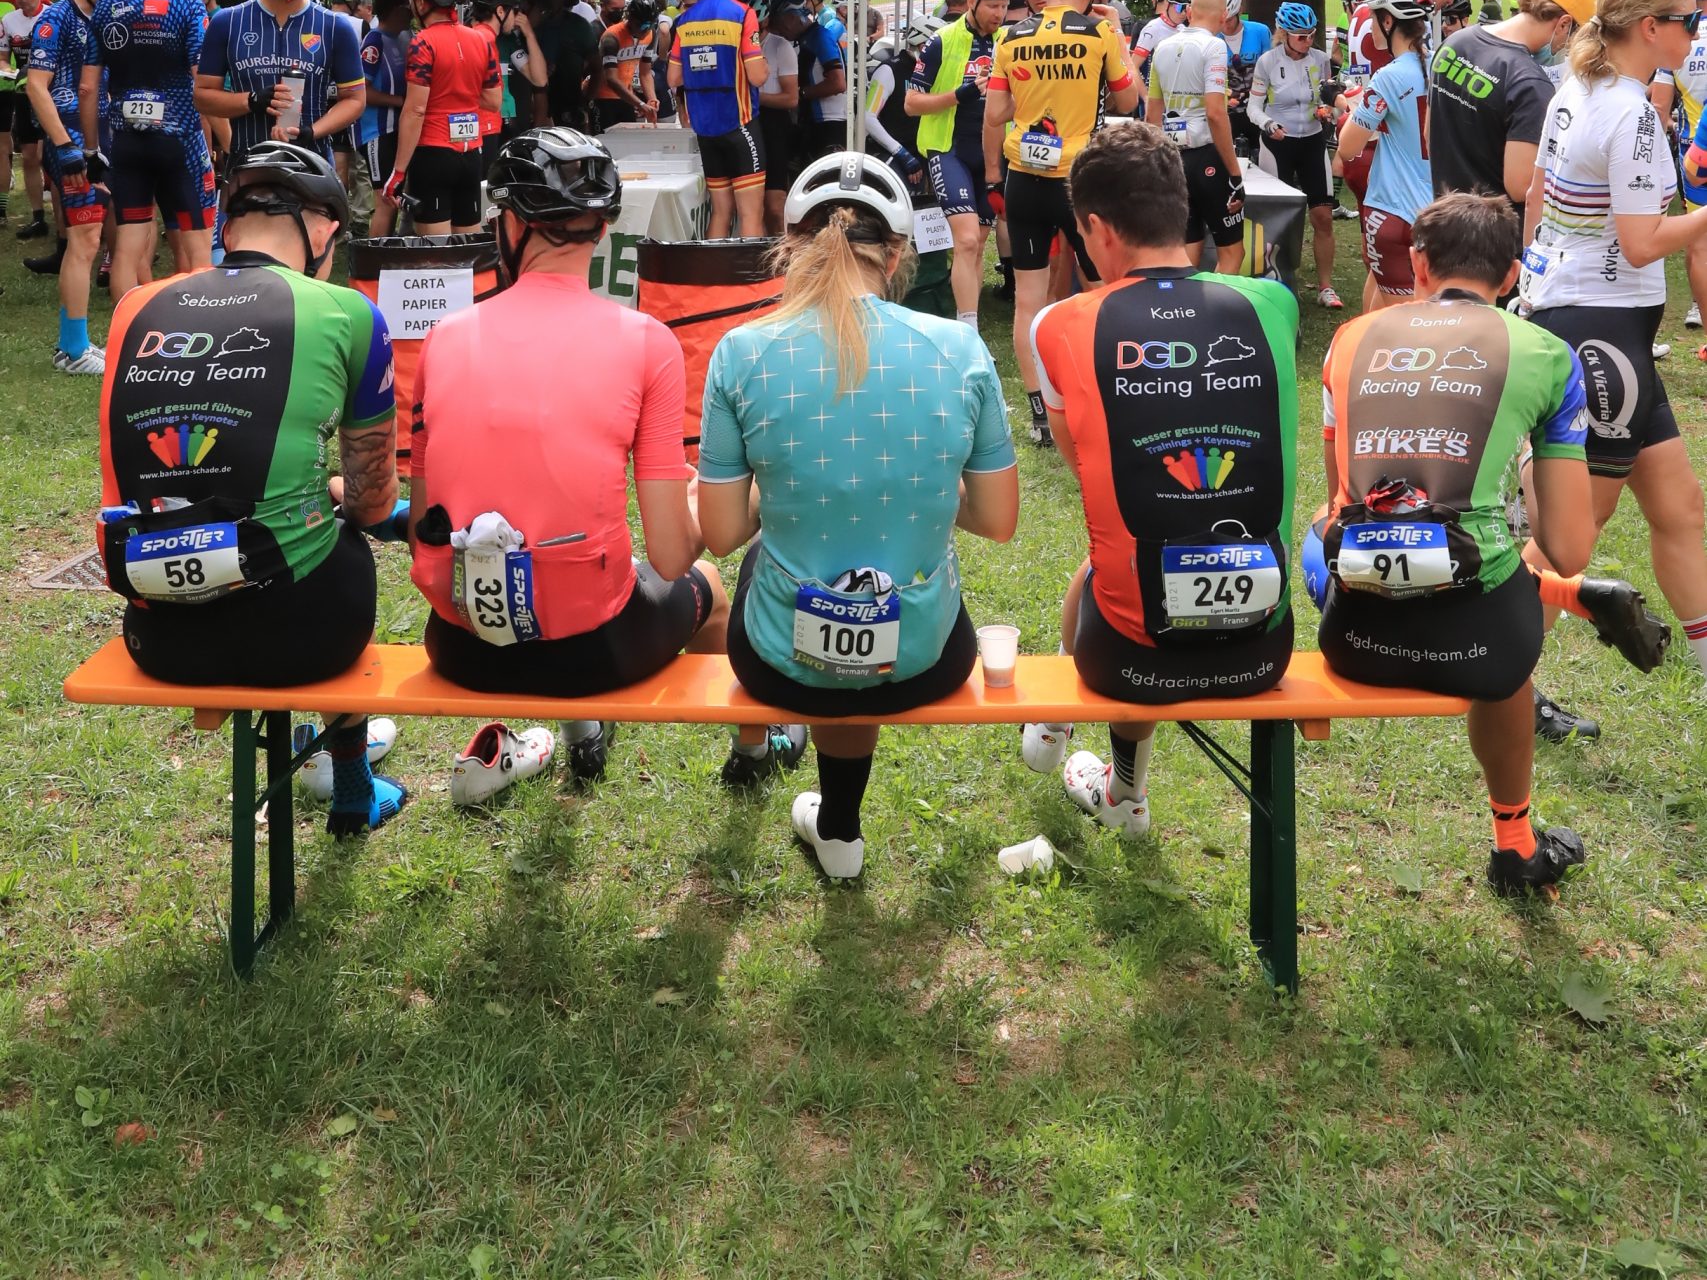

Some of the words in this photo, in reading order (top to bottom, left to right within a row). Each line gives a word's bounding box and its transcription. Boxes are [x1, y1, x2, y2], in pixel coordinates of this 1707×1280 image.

[698, 54, 709, 64] 94
[1012, 43, 1087, 62] JUMBO
[30, 59, 56, 69] URICH
[1035, 63, 1087, 80] VISMA
[1431, 46, 1494, 99] Giro
[1689, 60, 1707, 71] BR
[130, 103, 153, 115] 213
[458, 124, 474, 135] 210
[740, 124, 760, 172] MARSCHALL
[1027, 145, 1050, 161] 142
[930, 155, 947, 198] FENIX
[925, 224, 946, 234] PLASTIK
[928, 237, 949, 246] PLASTIC
[1365, 210, 1388, 276] Alpecin
[404, 278, 446, 290] CARTA
[178, 292, 258, 309] Sebastian
[402, 299, 447, 310] PAPIER
[1150, 307, 1196, 320] Katie
[1410, 316, 1463, 328] Daniel
[404, 320, 440, 332] PAPE
[136, 331, 214, 358] DGD
[1117, 341, 1198, 370] DGD
[1367, 347, 1436, 373] DGD
[1584, 349, 1601, 366] CK
[124, 365, 196, 387] Racing
[204, 363, 267, 382] Team
[1115, 376, 1192, 398] Racing
[1200, 372, 1261, 391] Team
[1359, 378, 1421, 397] Racing
[1428, 375, 1482, 397] Team
[1592, 370, 1612, 420] Victoria
[126, 406, 162, 423] besser
[164, 401, 209, 414] gesund
[211, 402, 253, 419] führen
[134, 415, 180, 431] Trainings
[191, 413, 240, 427] Keynotes
[1132, 428, 1172, 448] besser
[1174, 424, 1218, 439] gesund
[1221, 424, 1261, 439] führen
[1357, 426, 1469, 442] rodenstein
[1145, 437, 1192, 455] Trainings
[1203, 435, 1252, 449] Keynotes
[1354, 437, 1468, 457] BIKES
[139, 466, 232, 480] www.barbara-schade.de
[1156, 486, 1255, 500] www.barbara-schade.de
[141, 528, 225, 553] SPORTLER
[1356, 525, 1434, 545] SPORTLER
[1180, 547, 1262, 568] SPORTLER
[1373, 553, 1410, 582] 91
[164, 558, 206, 588] 58
[186, 589, 219, 601] Germany
[513, 567, 534, 634] SPORTLER
[1168, 581, 1180, 610] 2021
[1193, 575, 1254, 607] 249
[1391, 588, 1425, 597] Germany
[474, 578, 507, 628] 323
[810, 597, 890, 622] SPORTLER
[1172, 617, 1208, 628] Giro
[1223, 616, 1249, 625] France
[819, 623, 875, 657] 100
[1345, 630, 1488, 663] dgd-racing-team.de
[835, 666, 870, 676] Germany
[1121, 661, 1274, 688] dgd-racing-team.de
